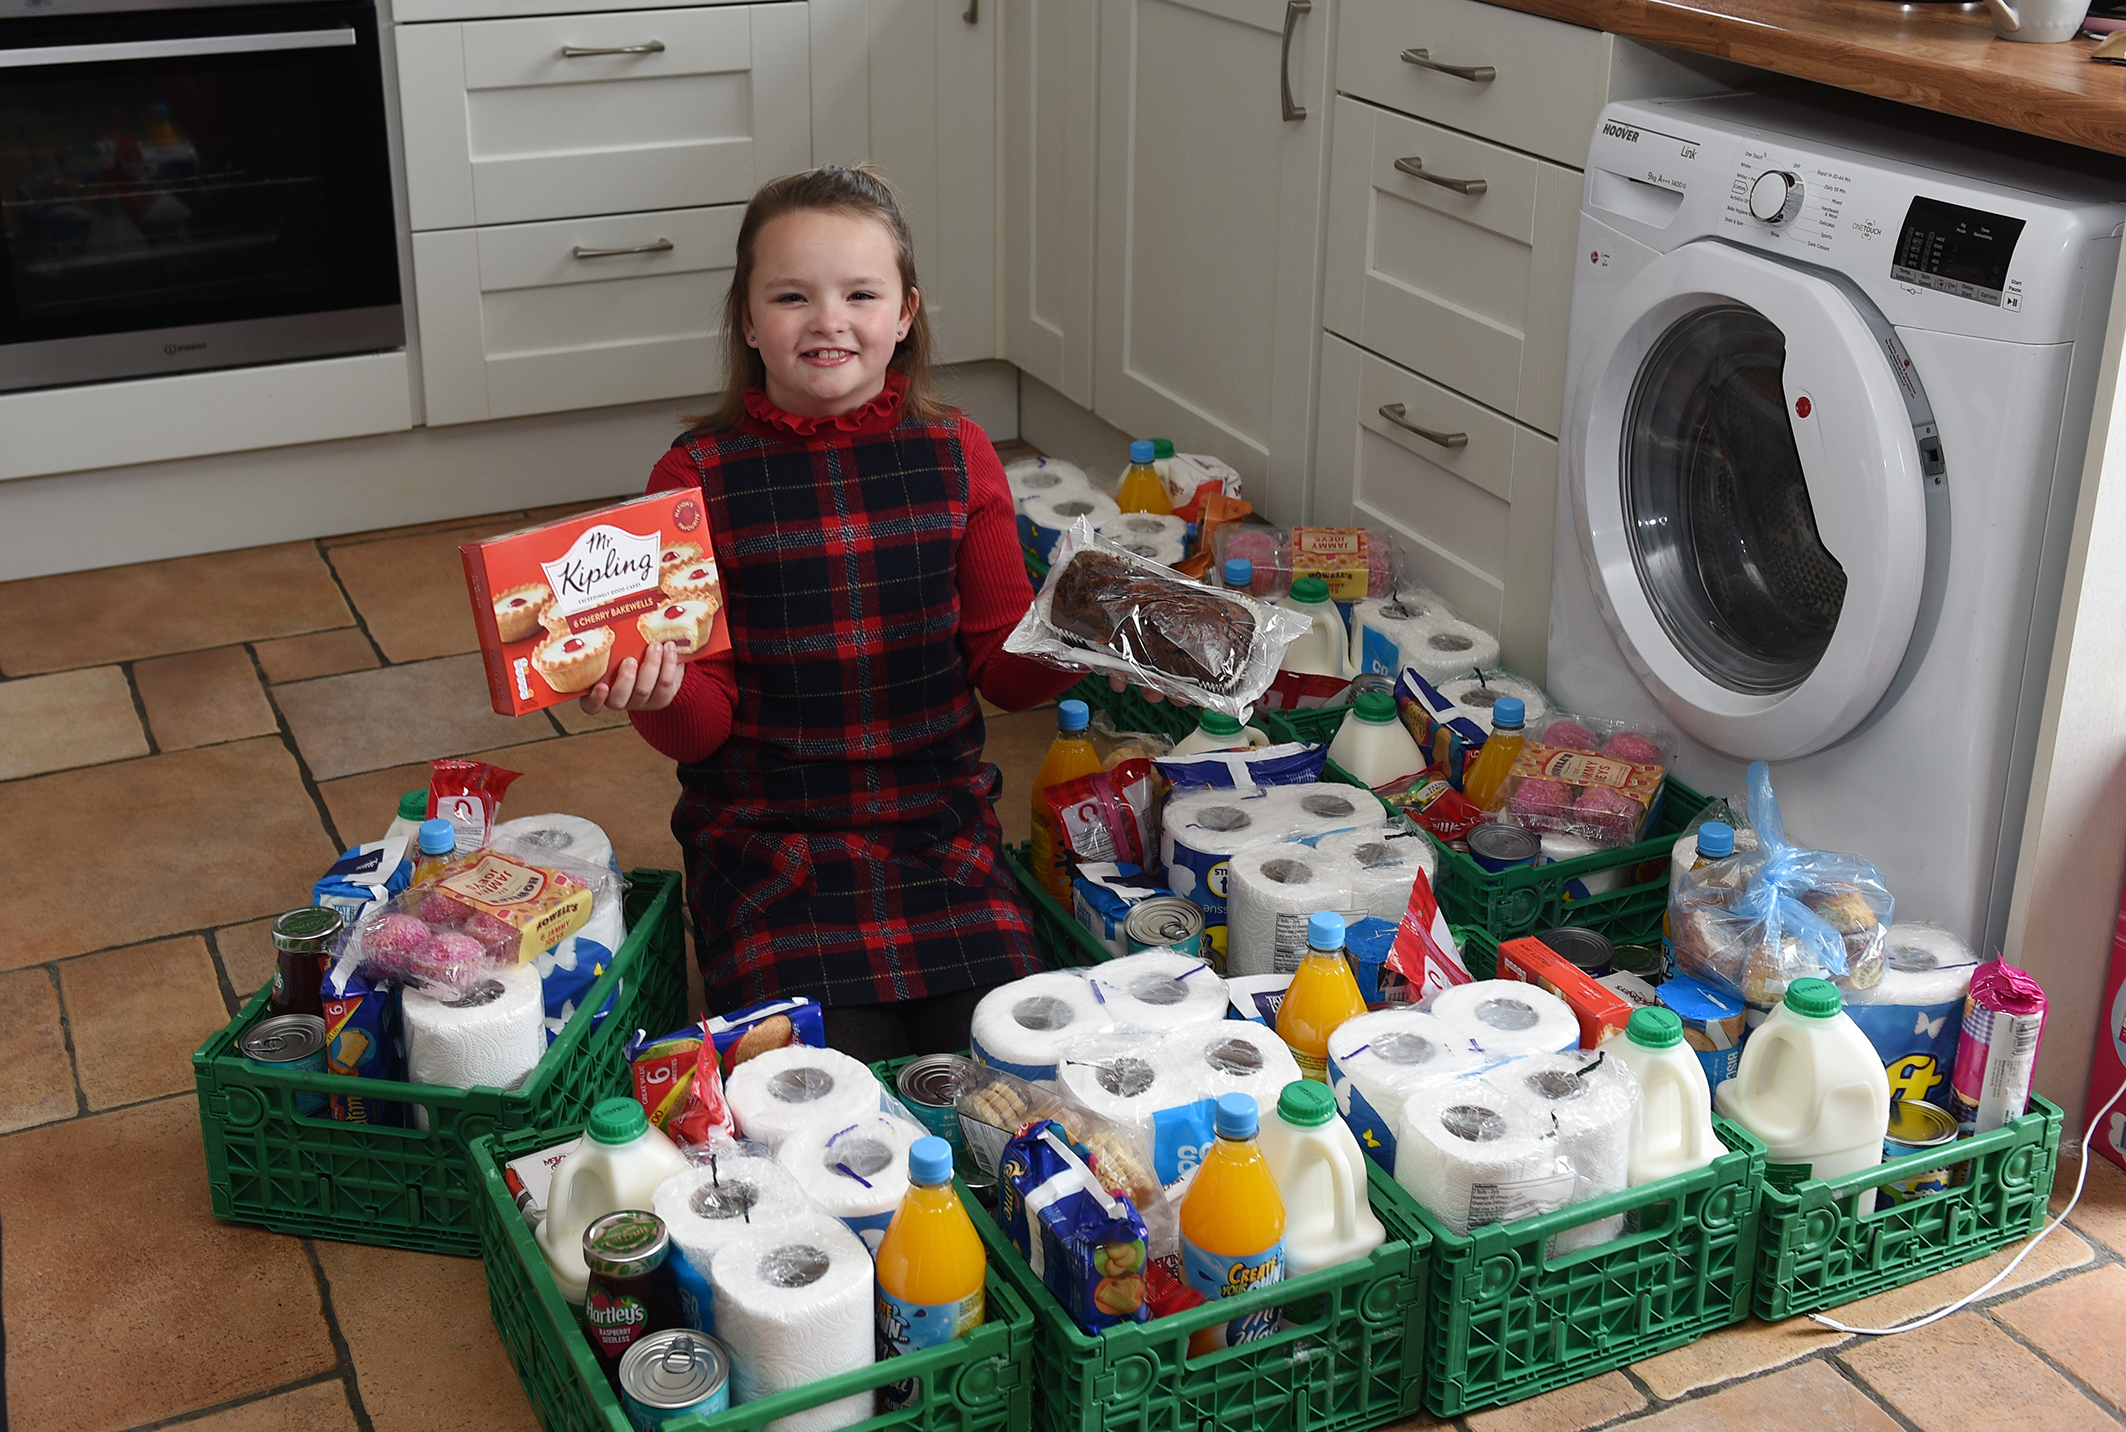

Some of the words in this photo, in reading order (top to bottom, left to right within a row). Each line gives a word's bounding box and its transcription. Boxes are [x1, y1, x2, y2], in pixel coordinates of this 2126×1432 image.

[1602, 123, 1640, 143] HOOVER
[1680, 145, 1698, 160] Link
[1647, 171, 1657, 183] 9kg
[1817, 169, 1828, 178] Rapid
[1824, 184, 1834, 192] Daily
[1821, 206, 1840, 214] Handwash
[1724, 216, 1733, 224] Drain
[1819, 220, 1835, 229] Delicates
[1820, 232, 1833, 240] Sports
[1807, 240, 1816, 248] Dark
[1816, 242, 1831, 252] Colours
[1980, 292, 1998, 301] Options
[585, 532, 613, 554] Mr
[557, 548, 654, 596] Kipling
[626, 582, 642, 591] CAKES
[573, 620, 579, 628] 6
[579, 609, 611, 627] CHERRY
[610, 597, 654, 618] BAKEWELLS
[332, 904, 355, 914] TATE
[1203, 904, 1228, 914] ssue
[547, 919, 571, 938] JAMMY
[329, 1003, 344, 1016] 6
[1725, 1051, 1739, 1080] BISC
[647, 1066, 671, 1085] 6
[1228, 1255, 1277, 1285] CREATE
[1222, 1283, 1247, 1297] YOUR
[586, 1300, 644, 1326] Hartley's
[599, 1327, 631, 1337] RASPBERRY
[602, 1335, 630, 1344] SEEDLESS
